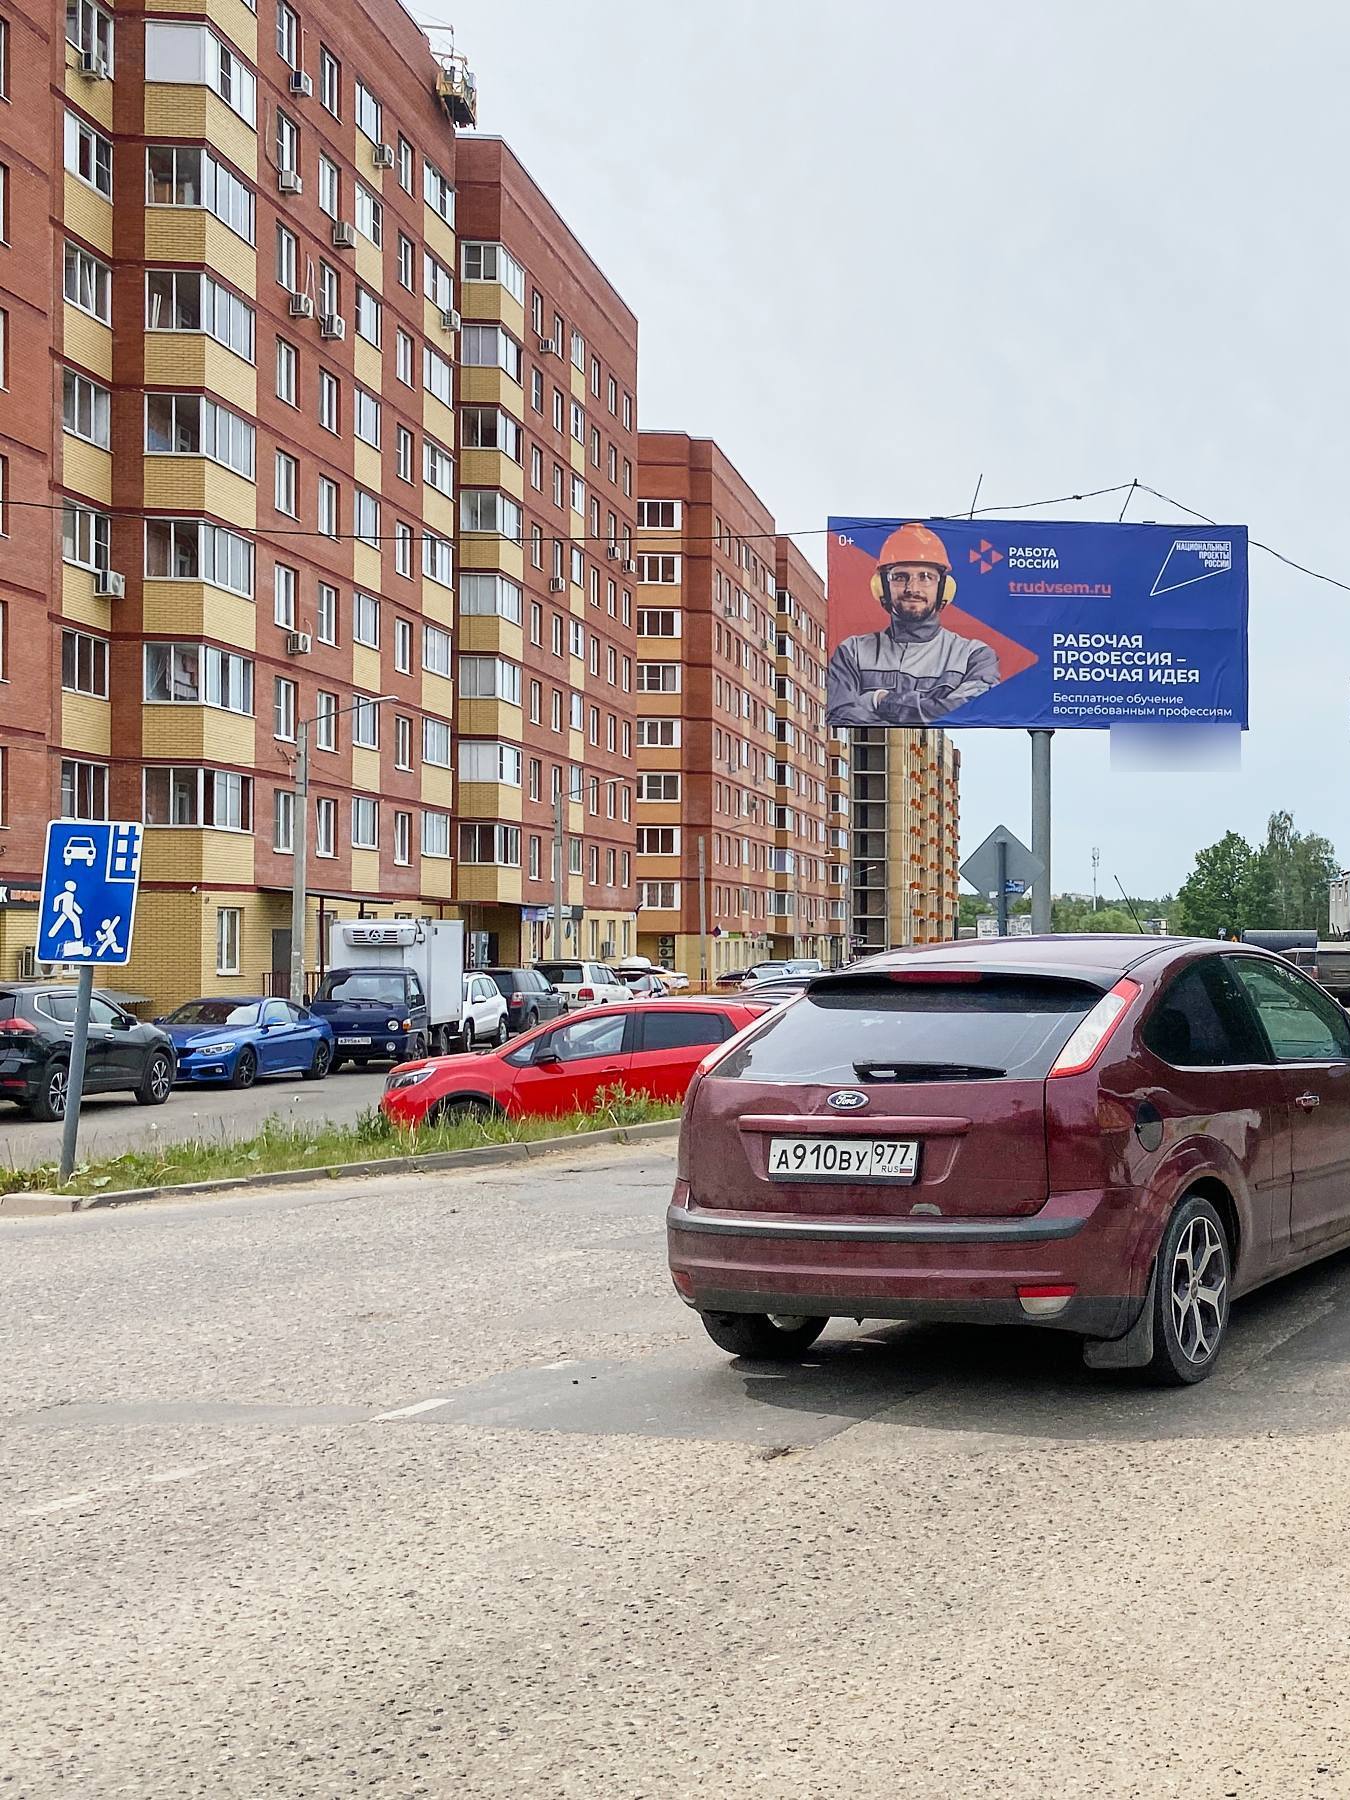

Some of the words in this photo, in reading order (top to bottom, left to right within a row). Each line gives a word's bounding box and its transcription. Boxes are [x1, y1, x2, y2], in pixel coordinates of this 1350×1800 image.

[838, 535, 854, 546] 0+
[1009, 547, 1057, 557] РАБОТА
[1176, 543, 1229, 551] НАЦИОНАЛЬНЫЕ
[1199, 551, 1229, 559] ПРОЕКТЫ
[1009, 558, 1059, 569] РОССИИ
[1204, 560, 1229, 568] РОССИИ
[1008, 581, 1111, 594] trudvsem.ru
[1053, 634, 1143, 648] РАБОЧАЯ
[1053, 650, 1172, 665] ПРОФЕССИЯ
[1053, 668, 1143, 682] РАБОЧАЯ
[1149, 669, 1200, 684] ИДЕЯ
[1053, 692, 1124, 703] Бесплатное
[1126, 693, 1184, 706] обучение
[1053, 704, 1155, 716] востребованным
[1158, 706, 1232, 718] профессиям
[836, 1094, 858, 1106] Ford
[874, 1144, 911, 1165] 977
[882, 1165, 899, 1173] RUS
